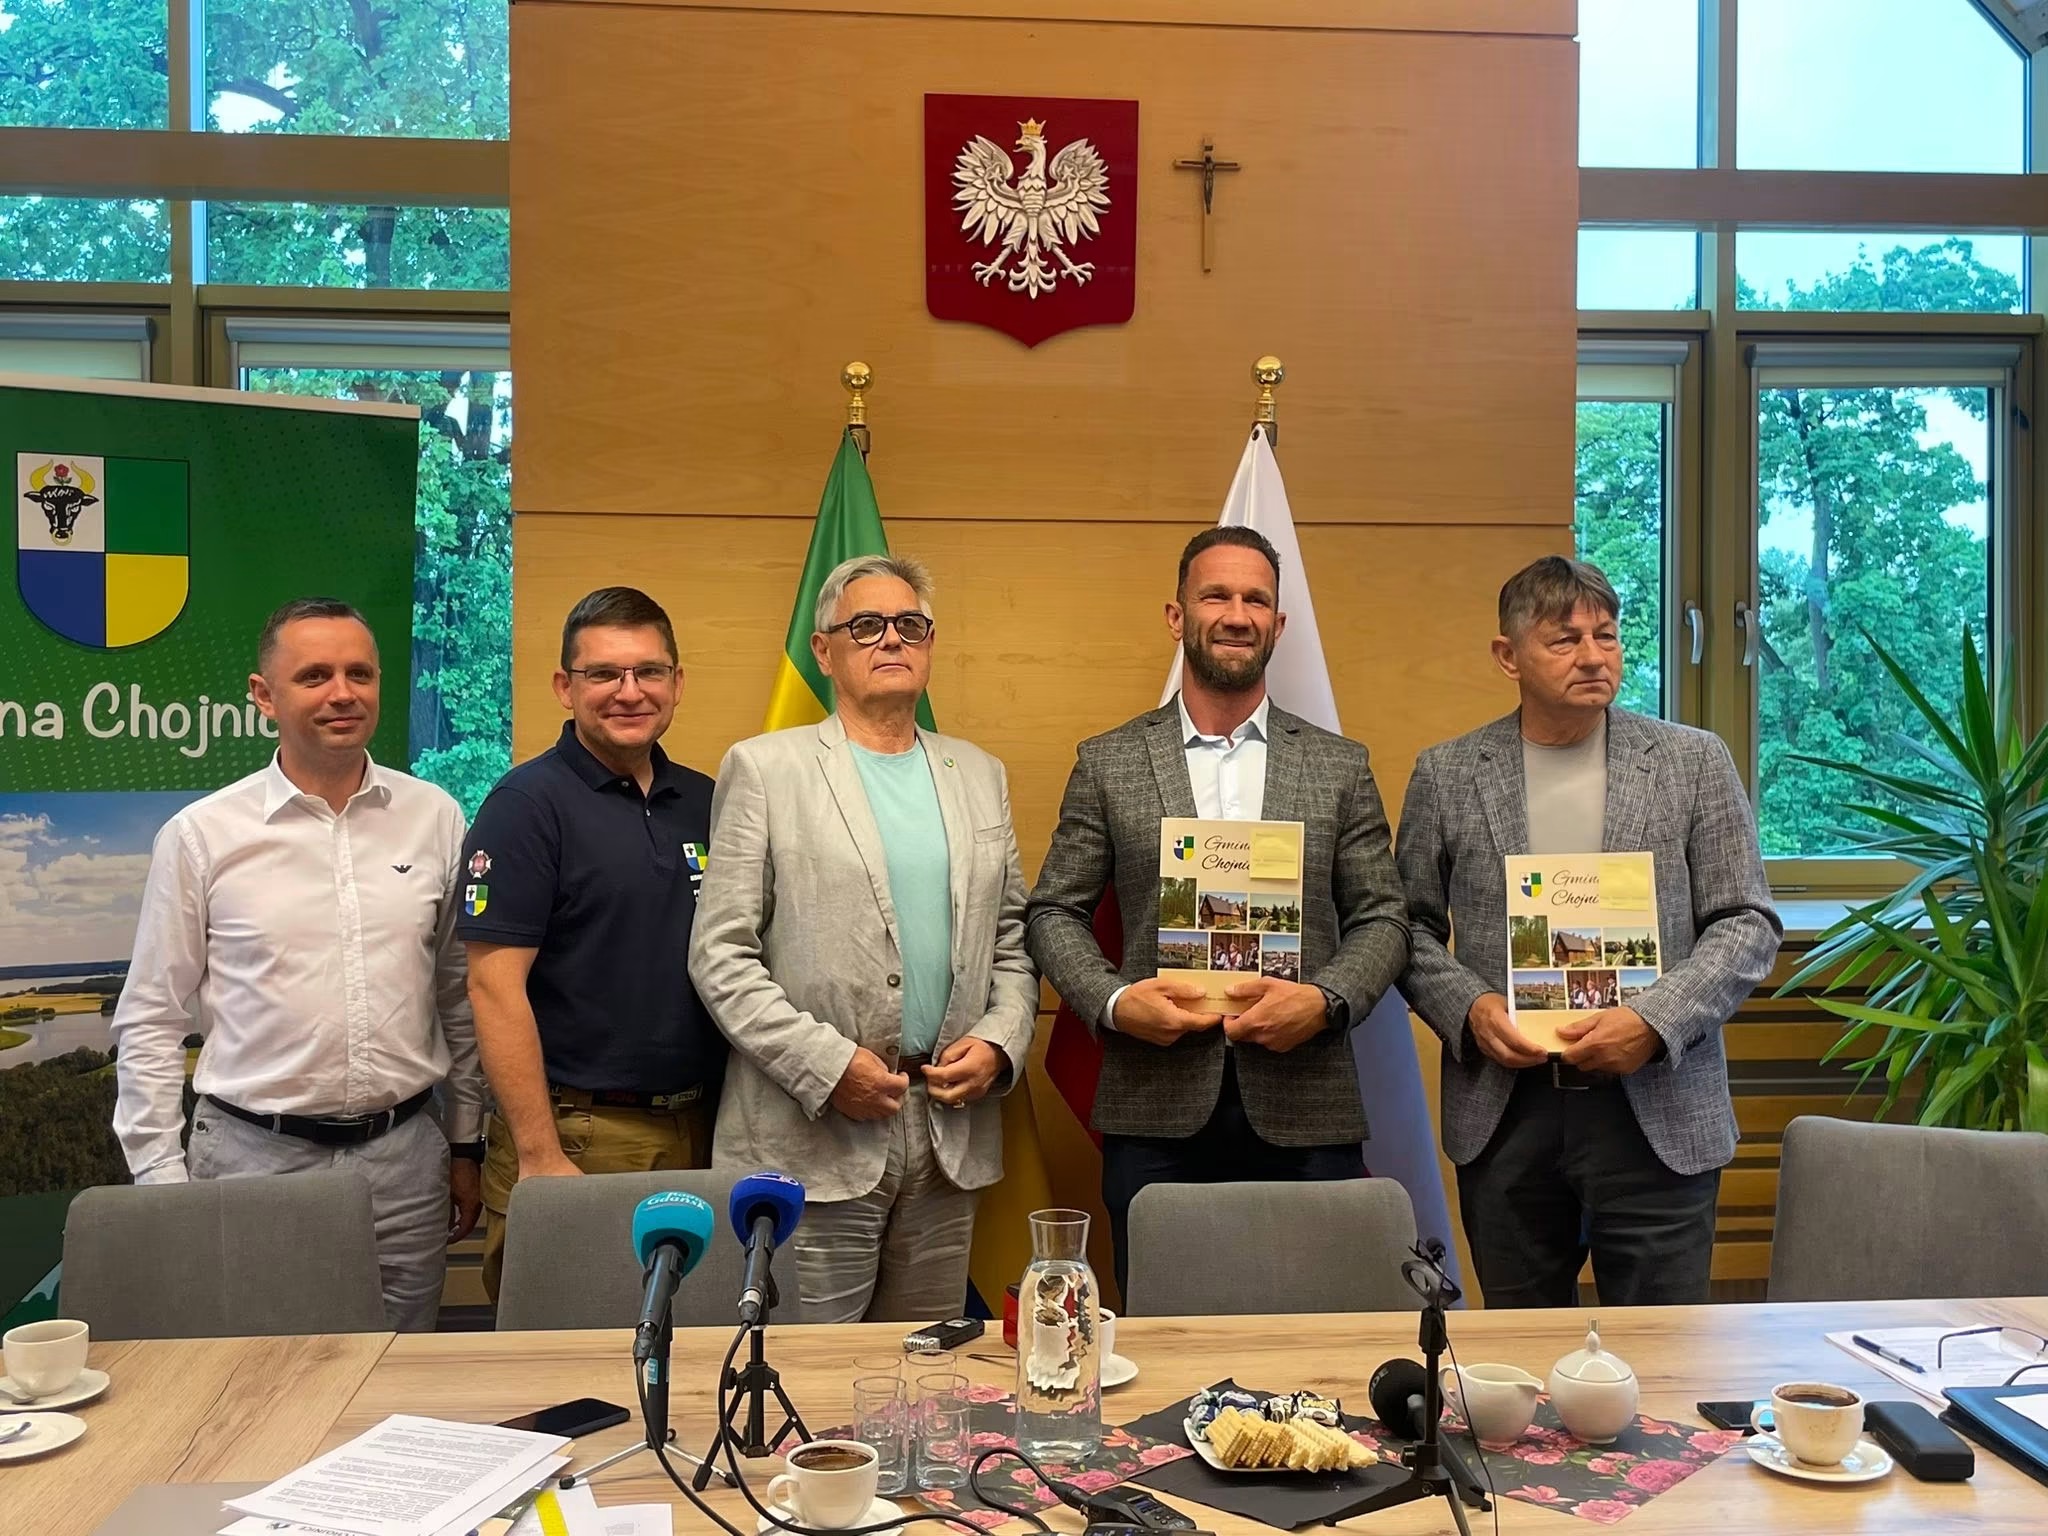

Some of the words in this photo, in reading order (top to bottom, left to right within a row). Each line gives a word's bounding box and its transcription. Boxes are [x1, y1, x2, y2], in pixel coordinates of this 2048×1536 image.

[82, 681, 280, 758] Chojnic
[1204, 835, 1250, 851] Gmin
[1552, 869, 1599, 886] Gmin
[1551, 889, 1600, 908] Chojni
